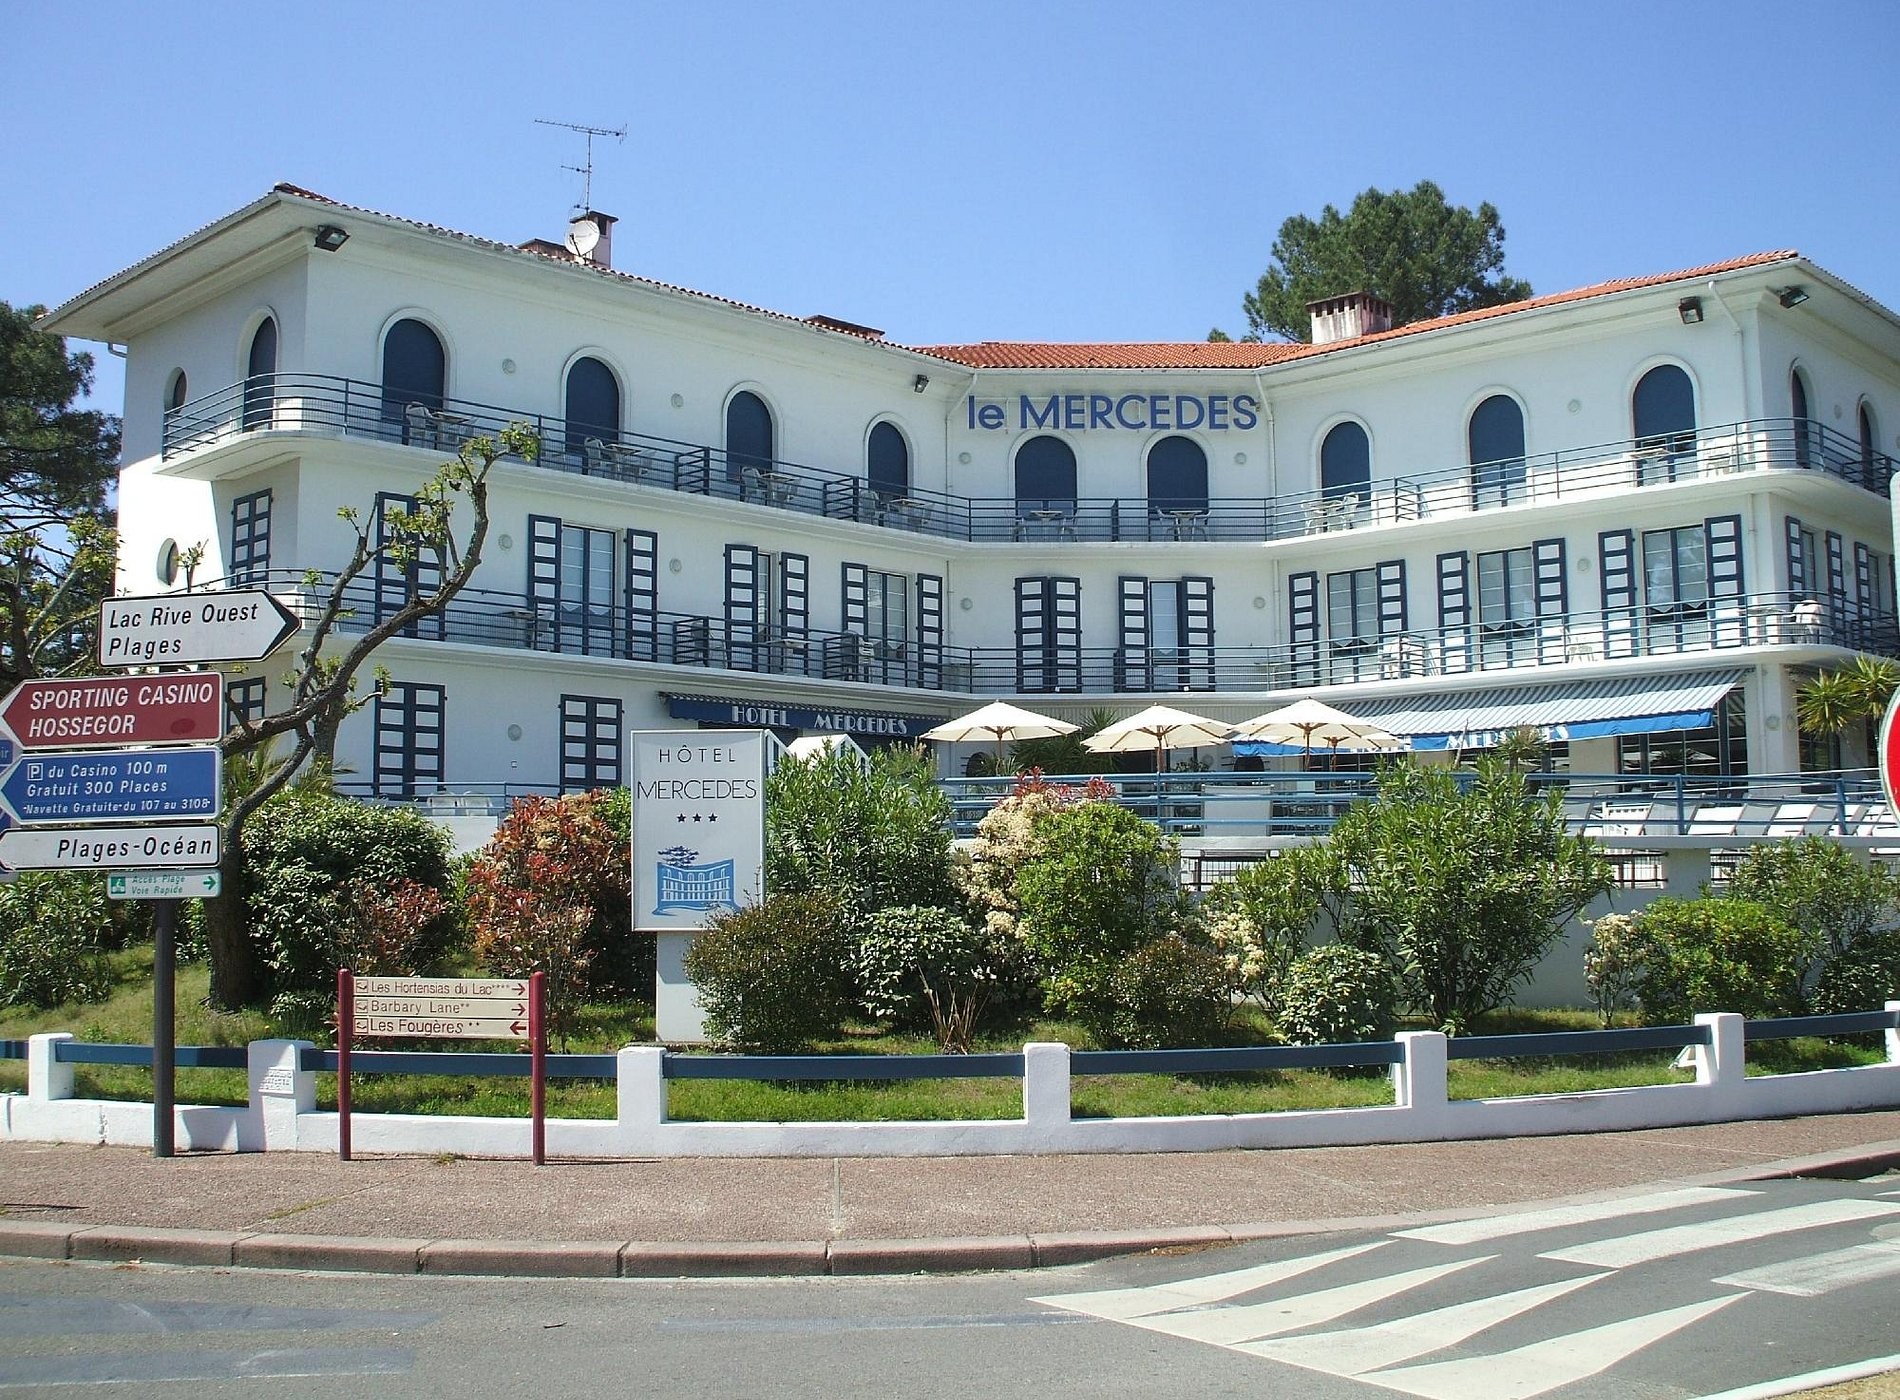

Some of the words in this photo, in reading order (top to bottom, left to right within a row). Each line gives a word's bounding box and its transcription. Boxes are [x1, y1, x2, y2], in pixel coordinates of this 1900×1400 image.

[968, 395, 1004, 430] le
[1020, 394, 1257, 430] MERCEDES
[109, 610, 142, 629] Lac
[150, 607, 192, 626] Rive
[202, 603, 258, 623] Ouest
[109, 637, 182, 660] Plages
[30, 687, 129, 710] SPORTING
[138, 682, 213, 706] CASINO
[28, 714, 136, 738] HOSSEGOR
[732, 706, 790, 726] HOTEL
[814, 714, 907, 735] MERCEDES
[659, 745, 736, 763] HÔTEL
[48, 766, 64, 778] du
[71, 764, 117, 777] Casino
[127, 762, 151, 775] 100
[156, 763, 167, 773] m
[27, 782, 78, 797] Gratuit
[85, 781, 113, 795] 300
[120, 780, 167, 794] Places
[637, 779, 757, 800] MERCEDES
[73, 801, 118, 813] Gratuite
[123, 801, 136, 811] du
[164, 801, 176, 810] au
[57, 836, 212, 862] Plages-Océan
[371, 982, 390, 993] Les
[396, 982, 449, 994] Hortensias
[454, 982, 468, 995] du
[371, 1000, 421, 1015] Barbary
[370, 1019, 393, 1031] Les
[399, 1019, 463, 1036] Fougères
